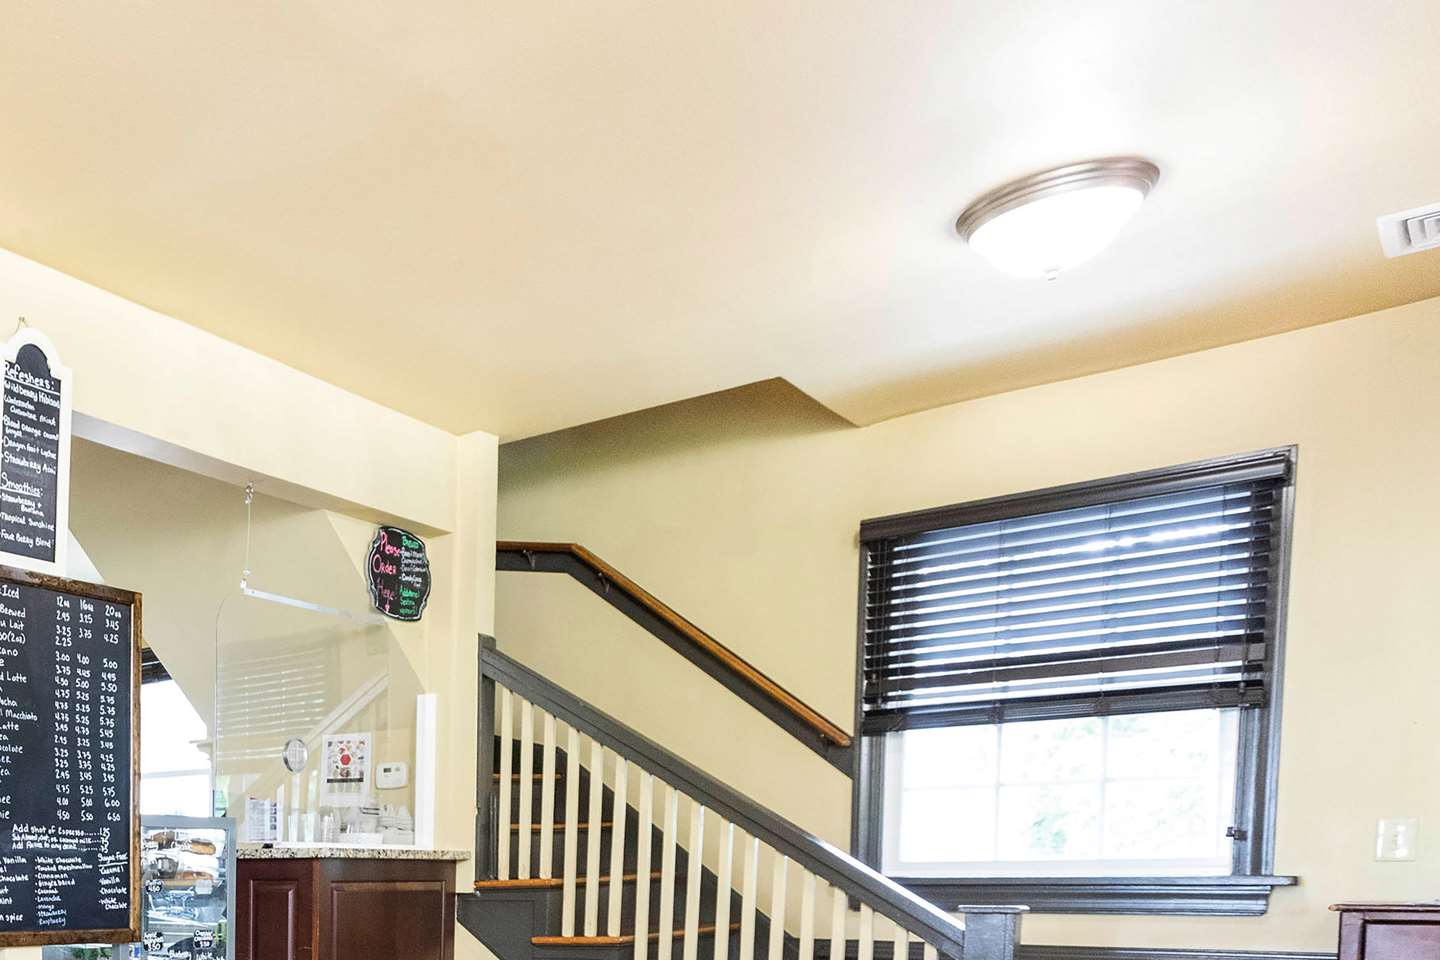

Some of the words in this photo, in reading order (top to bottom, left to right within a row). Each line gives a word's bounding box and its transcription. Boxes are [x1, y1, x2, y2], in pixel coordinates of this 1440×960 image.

[2, 585, 19, 599] Iced
[0, 603, 26, 618] Brewed
[10, 619, 24, 630] Lait
[7, 671, 27, 683] Latte
[12, 823, 29, 833] Add
